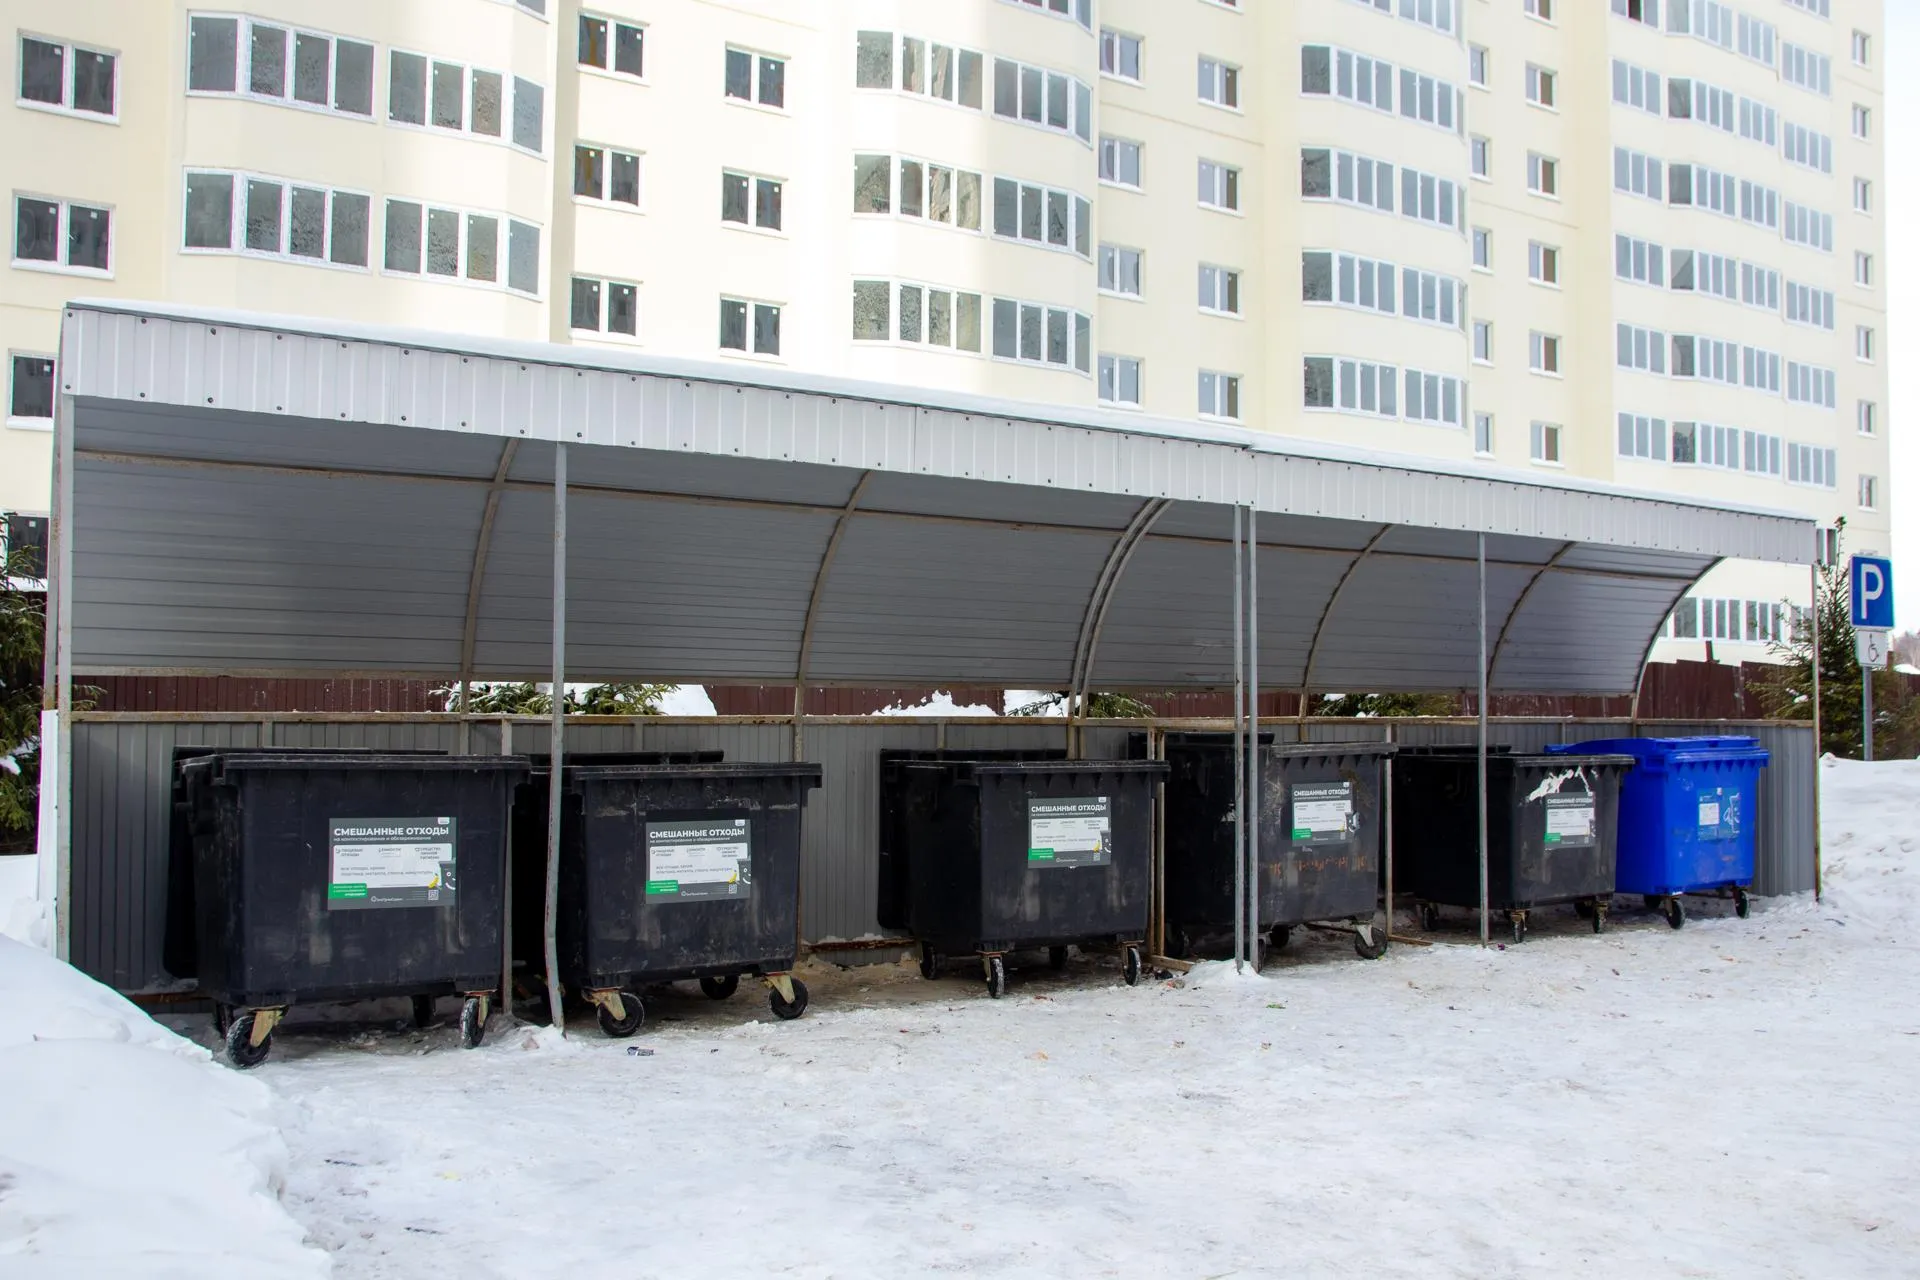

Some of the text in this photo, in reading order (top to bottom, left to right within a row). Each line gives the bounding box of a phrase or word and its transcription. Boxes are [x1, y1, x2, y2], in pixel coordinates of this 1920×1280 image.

[1861, 563, 1884, 619] P
[1031, 804, 1107, 813] СМЕШАННЫЕ ОТХОДЫ
[334, 827, 449, 836] СМЕШАННЫЕ ОТХОДЫ
[650, 828, 745, 838] СМЕШАННЫЕ ОТХОДЫ
